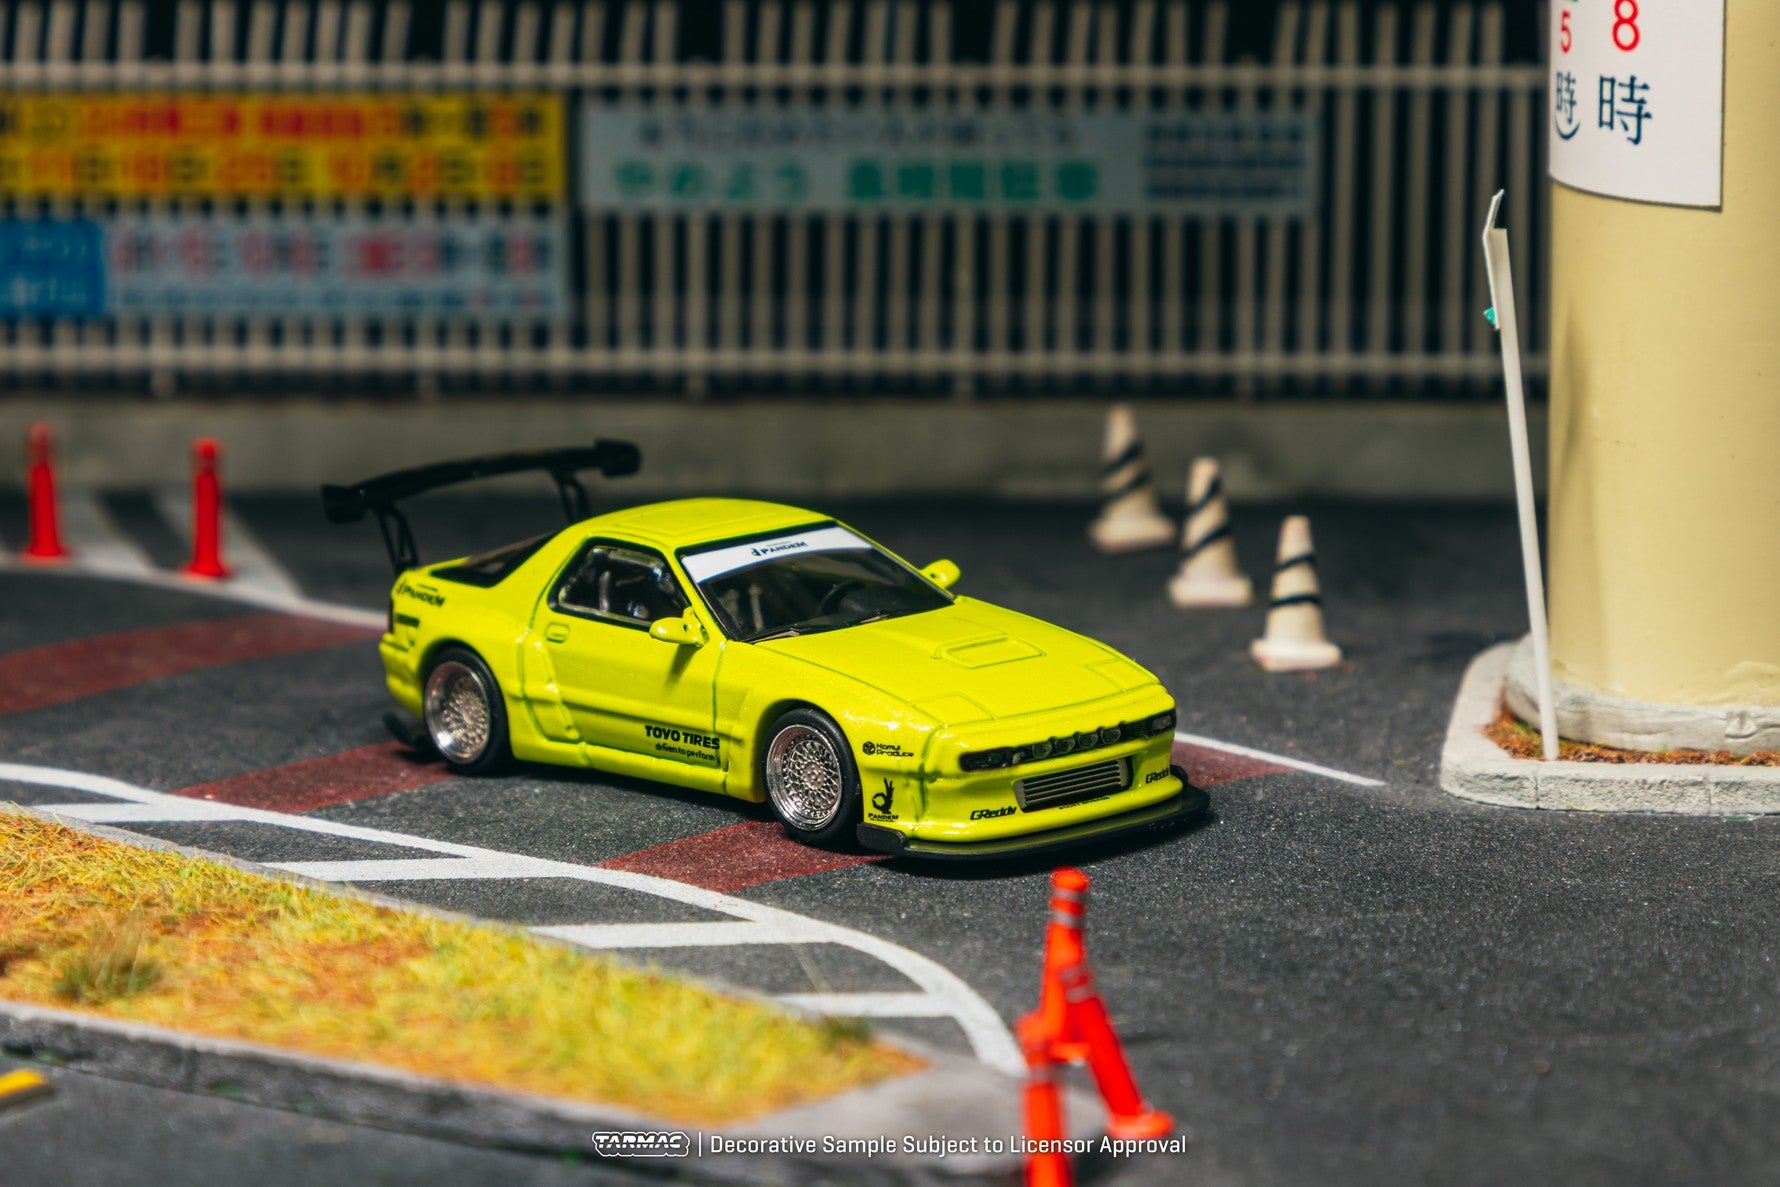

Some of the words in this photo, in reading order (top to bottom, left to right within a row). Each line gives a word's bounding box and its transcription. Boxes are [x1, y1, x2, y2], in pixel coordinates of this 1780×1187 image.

[645, 725, 680, 742] TOYO
[682, 731, 720, 749] TIRES
[655, 742, 677, 753] driven
[687, 749, 715, 760] perform
[876, 749, 914, 757] Produce
[868, 812, 898, 820] PANDEM
[970, 806, 1017, 820] GReddy
